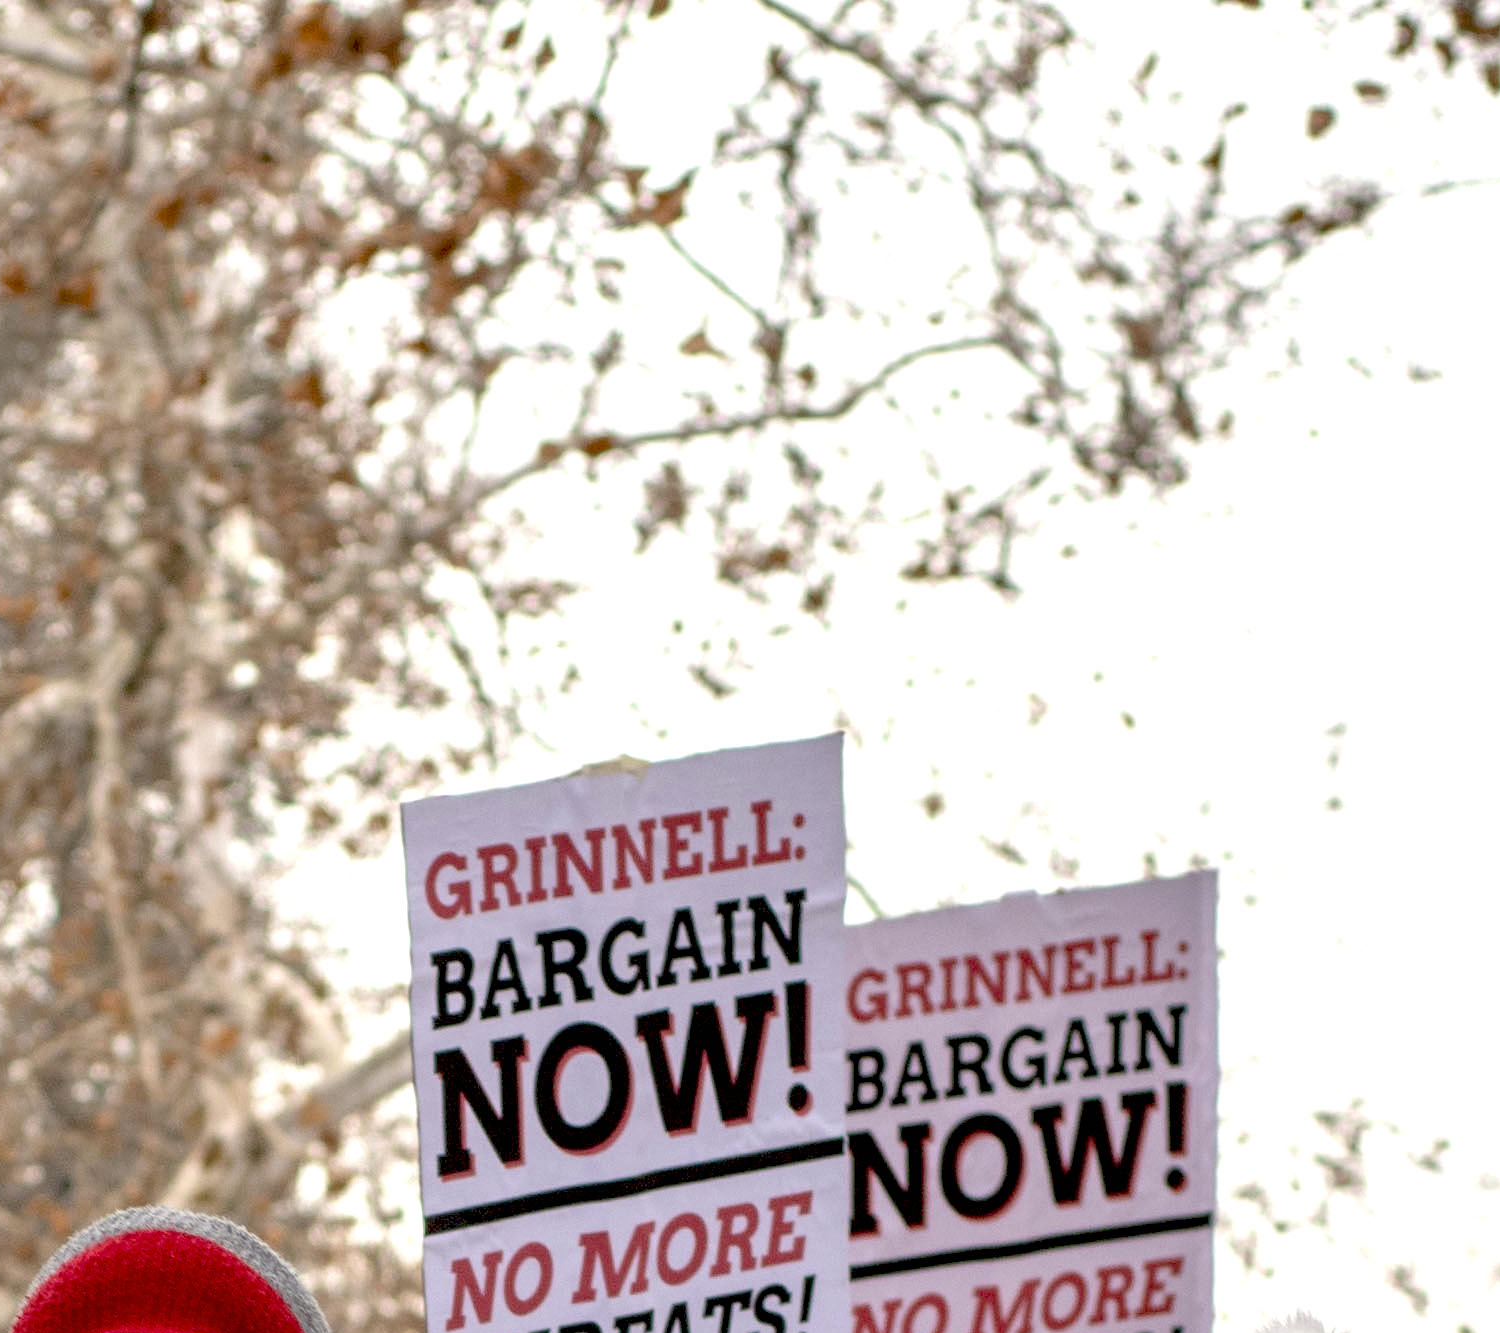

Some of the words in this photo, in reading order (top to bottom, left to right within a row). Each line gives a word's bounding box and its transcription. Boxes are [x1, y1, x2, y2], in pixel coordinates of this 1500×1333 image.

[425, 801, 808, 920] GRINNELL:
[430, 887, 808, 1031] BARGAIN
[846, 930, 1188, 1023] GRINNELL:
[434, 980, 813, 1180] NOW!
[845, 1004, 1187, 1114] BARGAIN
[847, 1081, 1188, 1240] NOW!
[446, 1241, 553, 1332] NO
[572, 1190, 814, 1306] MORE
